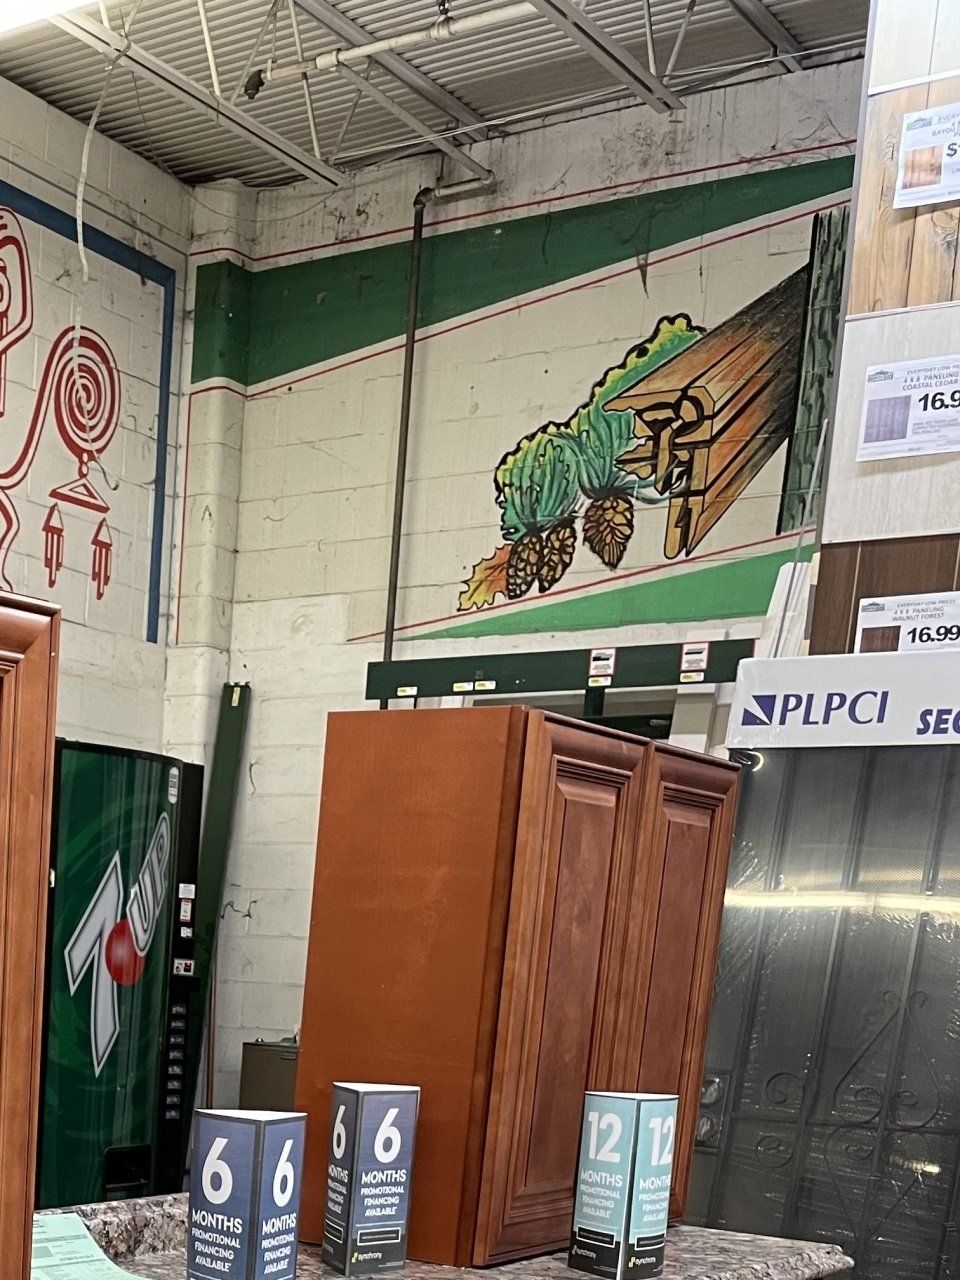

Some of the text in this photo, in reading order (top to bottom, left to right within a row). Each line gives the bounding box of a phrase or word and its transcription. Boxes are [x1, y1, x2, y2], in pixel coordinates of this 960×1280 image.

[902, 379, 958, 391] COASTAL CEDAR
[923, 371, 959, 381] PANELING
[891, 612, 945, 622] WALNUT FOREST
[912, 606, 945, 614] PANELING
[907, 625, 960, 644] 16.99
[778, 690, 890, 726] PLPCI
[332, 1105, 347, 1160] 6
[373, 1108, 402, 1164] 6
[588, 1111, 623, 1164] 12
[648, 1115, 675, 1167] 12
[201, 1137, 234, 1205] 6
[272, 1139, 295, 1208] 6
[361, 1168, 407, 1185] MONTHS
[580, 1168, 624, 1188] MONTHS
[360, 1185, 405, 1197] PROMOTIONAL
[580, 1183, 621, 1199] PROMOTIONAL
[364, 1196, 400, 1207] FINANCING
[191, 1208, 243, 1234] MONTHS
[262, 1213, 297, 1235] MONTHS
[191, 1227, 241, 1249] PROMOTIONAL
[261, 1233, 295, 1250] PROMOTIONAL
[194, 1241, 235, 1260] FINANCING
[263, 1246, 291, 1261] FINANCING
